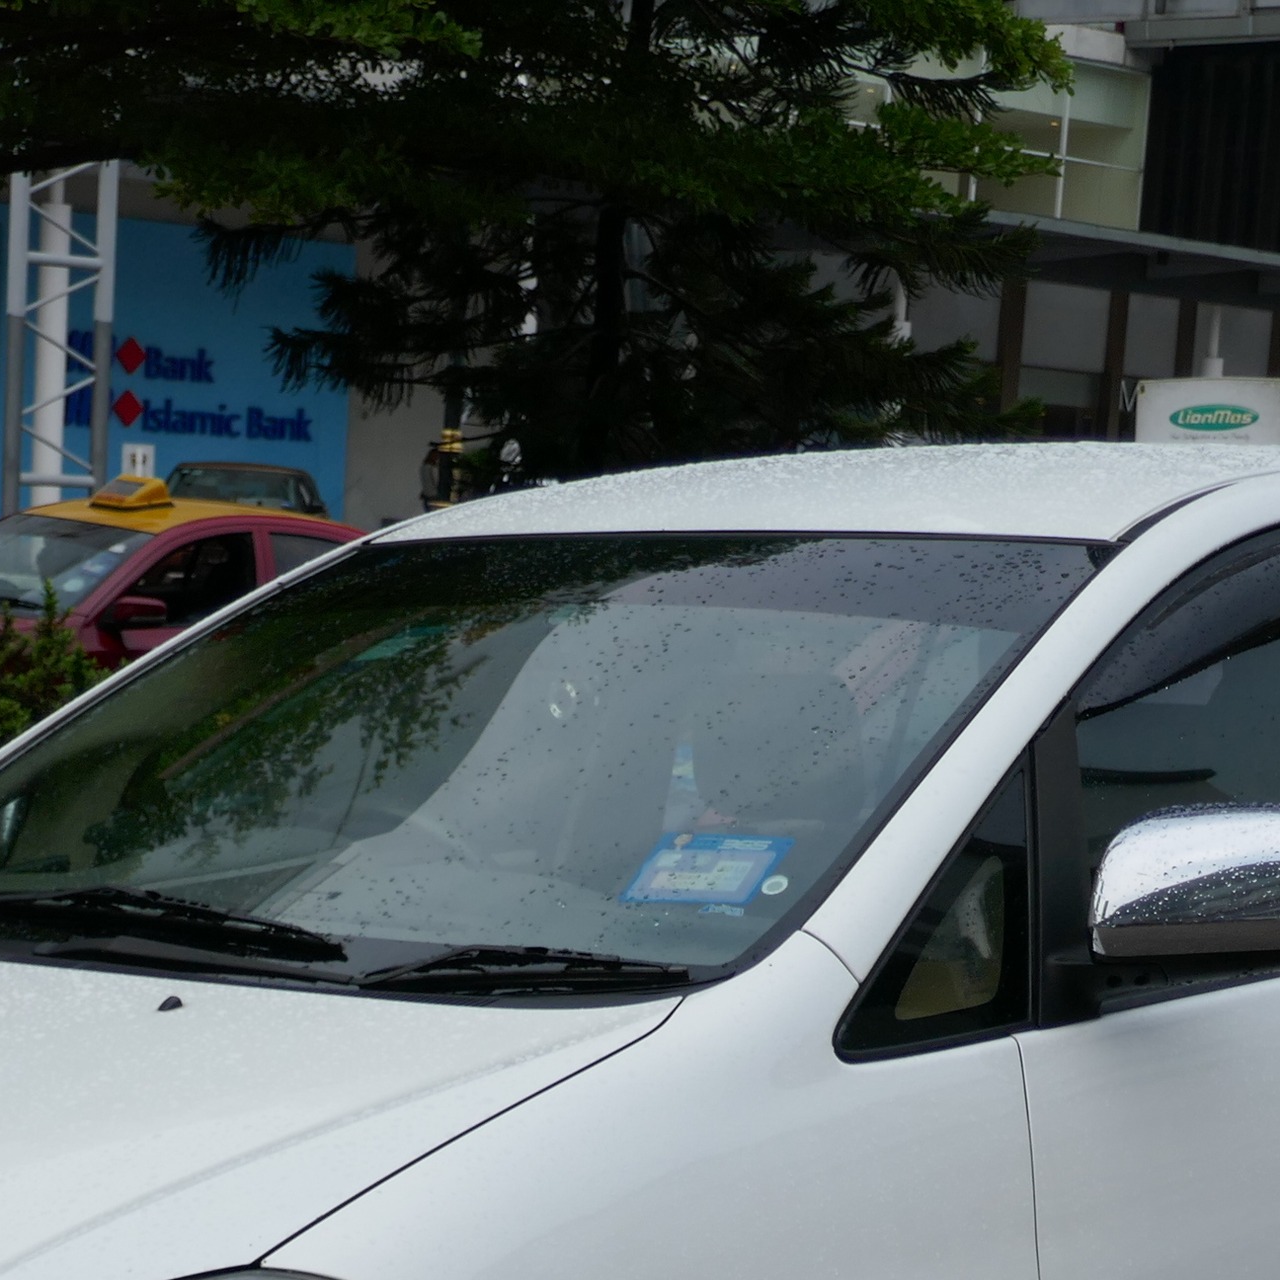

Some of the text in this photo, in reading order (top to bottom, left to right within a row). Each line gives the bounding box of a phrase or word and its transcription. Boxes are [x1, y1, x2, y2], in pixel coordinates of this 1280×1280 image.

[144, 346, 215, 384] Bank
[141, 399, 242, 438] Islamic
[246, 405, 313, 443] Bank
[1177, 408, 1254, 425] LionMas
